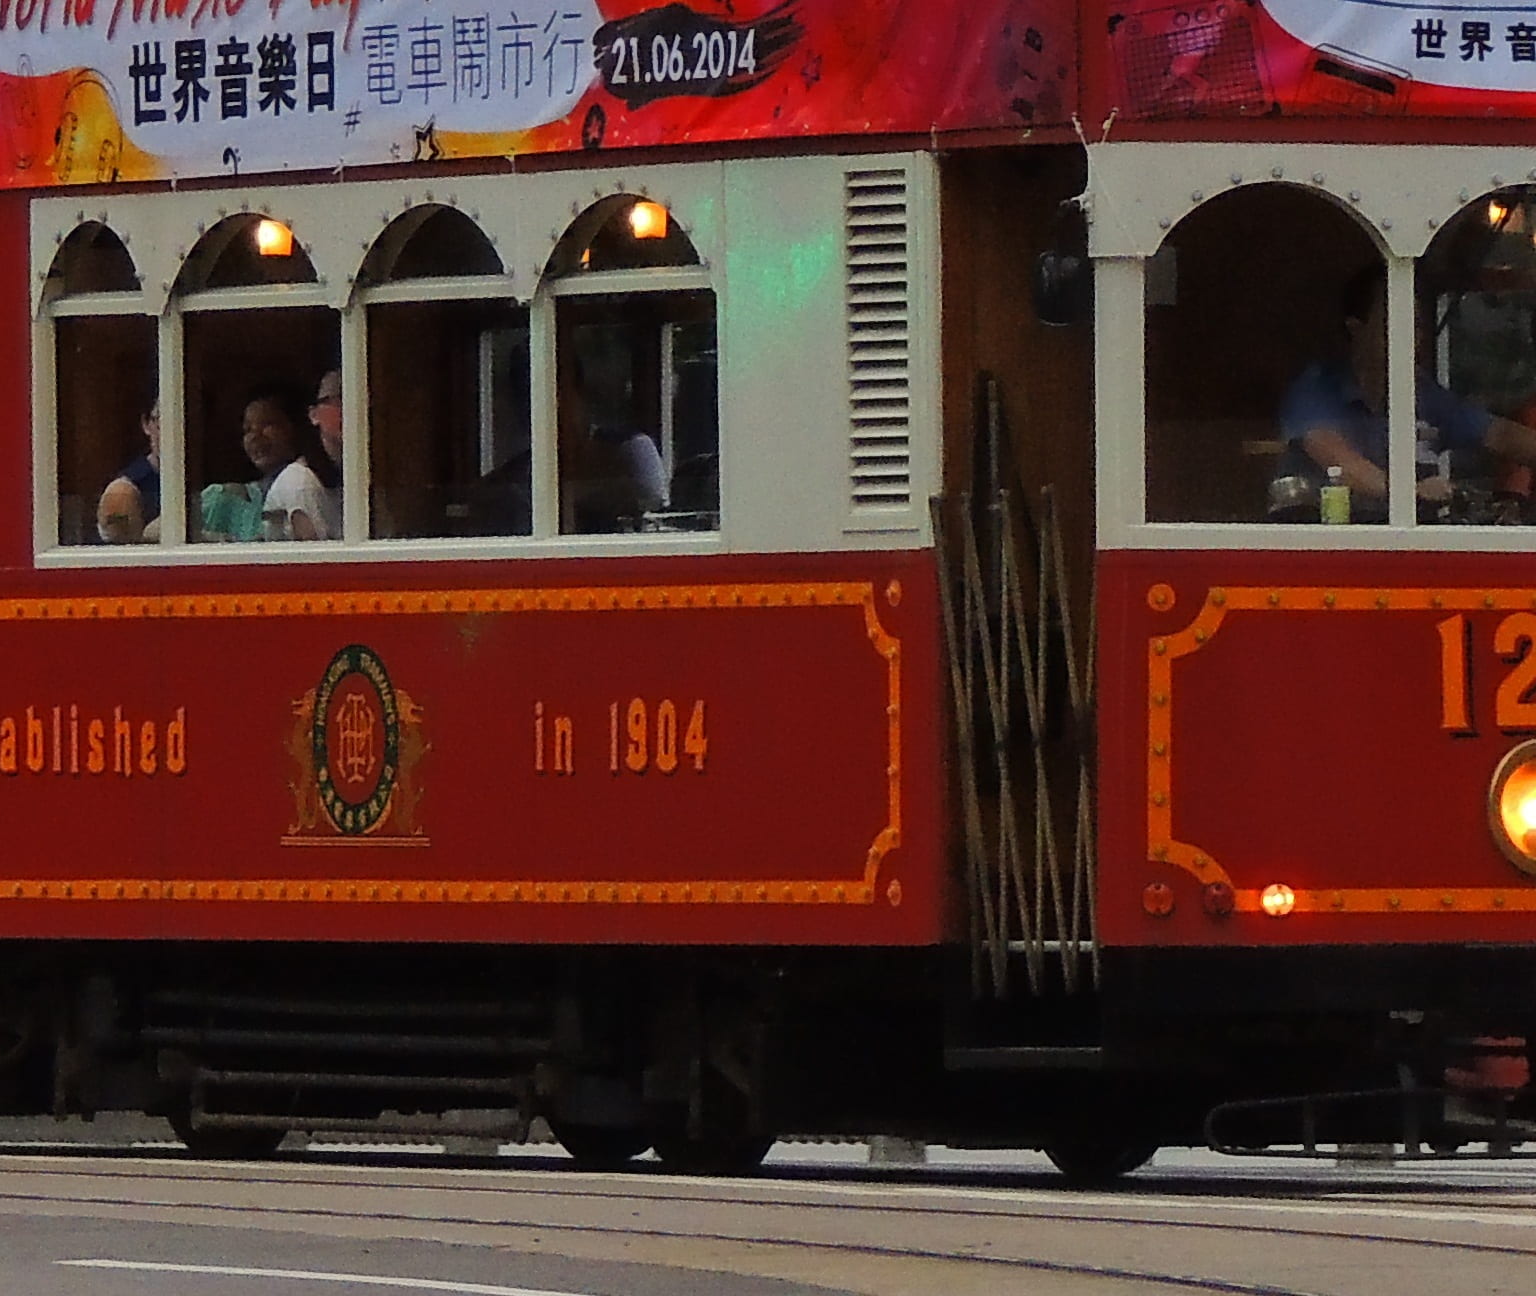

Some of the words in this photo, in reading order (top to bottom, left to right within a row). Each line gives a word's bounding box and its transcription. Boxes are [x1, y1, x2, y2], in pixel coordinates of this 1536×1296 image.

[128, 30, 336, 127] 世界音樂日
[363, 11, 586, 107] 電車鬧市行
[611, 29, 757, 84] 21.06.2014
[534, 701, 574, 774] in
[609, 697, 708, 773] 1904
